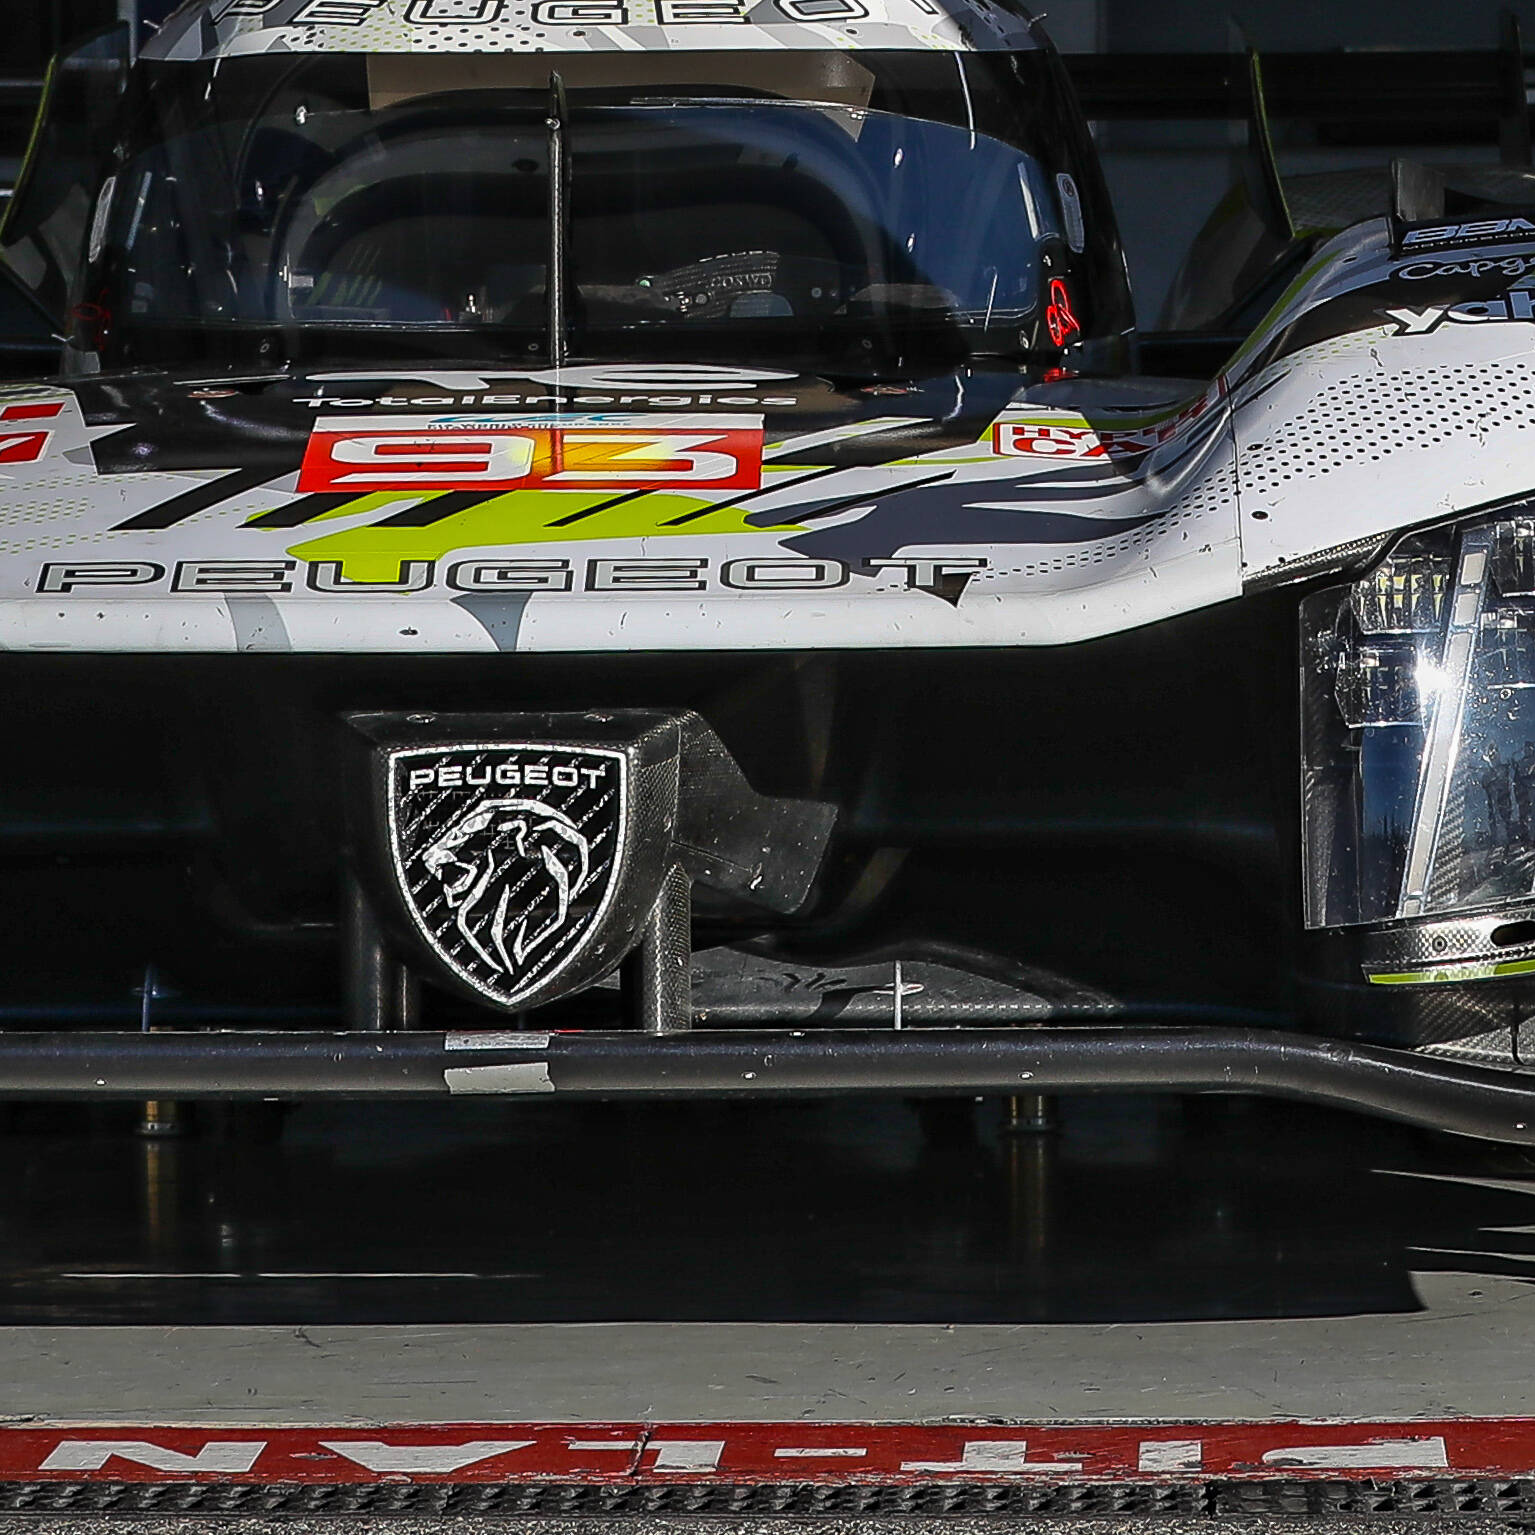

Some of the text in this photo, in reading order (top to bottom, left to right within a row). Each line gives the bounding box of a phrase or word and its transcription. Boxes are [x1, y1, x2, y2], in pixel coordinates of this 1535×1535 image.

[292, 393, 798, 409] TotalEnergies
[329, 432, 738, 484] 93
[35, 558, 988, 595] PEUGEOT
[409, 765, 608, 790] PEUGEOT
